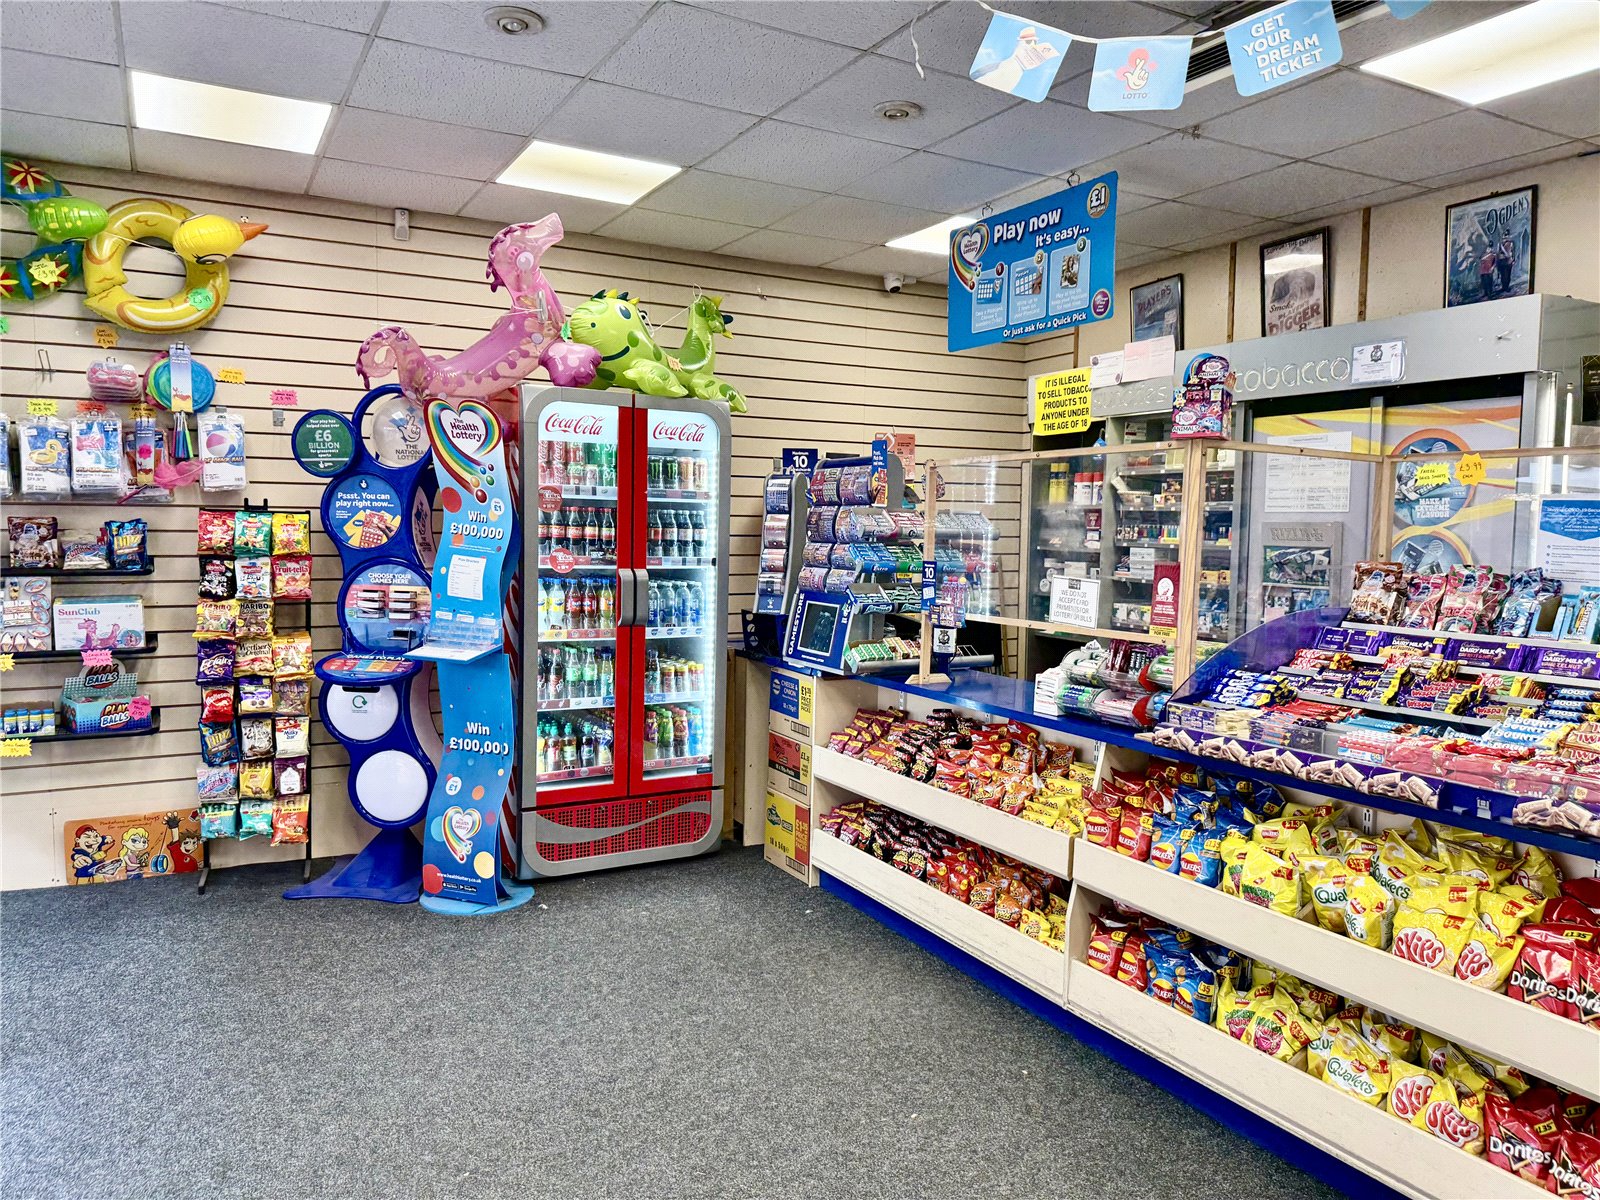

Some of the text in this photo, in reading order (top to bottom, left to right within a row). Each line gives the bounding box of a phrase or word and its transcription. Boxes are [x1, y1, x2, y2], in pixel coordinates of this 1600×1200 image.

[1250, 12, 1285, 37] GET
[1241, 29, 1292, 57] YOUR
[1256, 34, 1320, 69] DREAM
[1259, 48, 1324, 83] TICKET
[1090, 186, 1106, 209] £1
[993, 222, 1026, 244] Play
[1029, 208, 1062, 232] now
[1035, 225, 1089, 248] It's easy...
[1003, 312, 1087, 338] Or just ask for Quick Pick
[1045, 374, 1086, 388] IT IS ILLEGAL
[1233, 357, 1350, 393] tobacco
[1037, 391, 1047, 401] TO
[1047, 388, 1062, 399] SELL
[1043, 396, 1088, 411] PRODUCTS TO
[1041, 407, 1090, 422] ANYONE UNDER
[449, 421, 479, 432] Health
[545, 413, 606, 436] Coca-Cola
[1043, 418, 1088, 432] THE AGE OF 18
[314, 430, 332, 442] £6
[451, 430, 482, 443] Lottery
[652, 421, 708, 443] Coca-Cola
[308, 442, 340, 450] BILLION
[793, 456, 808, 468] 10
[336, 500, 351, 508] play
[352, 500, 371, 508] right
[1441, 497, 1450, 505] IT
[493, 504, 502, 512] £1
[468, 510, 487, 523] Win
[450, 522, 504, 540] £100,000
[275, 565, 309, 574] Fruit-tella
[368, 572, 392, 580] CHOOSE
[925, 567, 935, 579] 10
[202, 603, 231, 611] HARIBO
[1058, 597, 1076, 606] ACCEPT
[58, 607, 100, 617] SunClub
[1053, 611, 1073, 620] LOTTERY
[788, 592, 805, 655] GAMESTORE
[1409, 641, 1424, 649] MILK
[1478, 648, 1495, 656] MILK
[1542, 656, 1583, 666] DAIRY MILK
[91, 665, 118, 674] PLAY
[85, 673, 119, 687] BALLS
[1561, 688, 1590, 696] BOOST
[104, 703, 128, 715] PLAY
[1553, 699, 1581, 707] BOOST
[1548, 709, 1577, 717] BOOST
[100, 713, 130, 728] BALLS
[467, 721, 490, 736] Win
[1496, 731, 1542, 743] BOUNTY
[449, 737, 509, 756] £100,000
[448, 784, 457, 793] £1
[1151, 848, 1175, 861] WALKERS
[1394, 930, 1443, 968] Skips
[1087, 948, 1111, 964] WALKERS
[1511, 970, 1566, 1001] Doritos
[1311, 990, 1334, 1007] £1.35
[1340, 1007, 1360, 1019] £1.35
[1327, 1056, 1375, 1095] Quavers
[1393, 1078, 1436, 1118] Skip
[1490, 1135, 1551, 1164] Doritos
